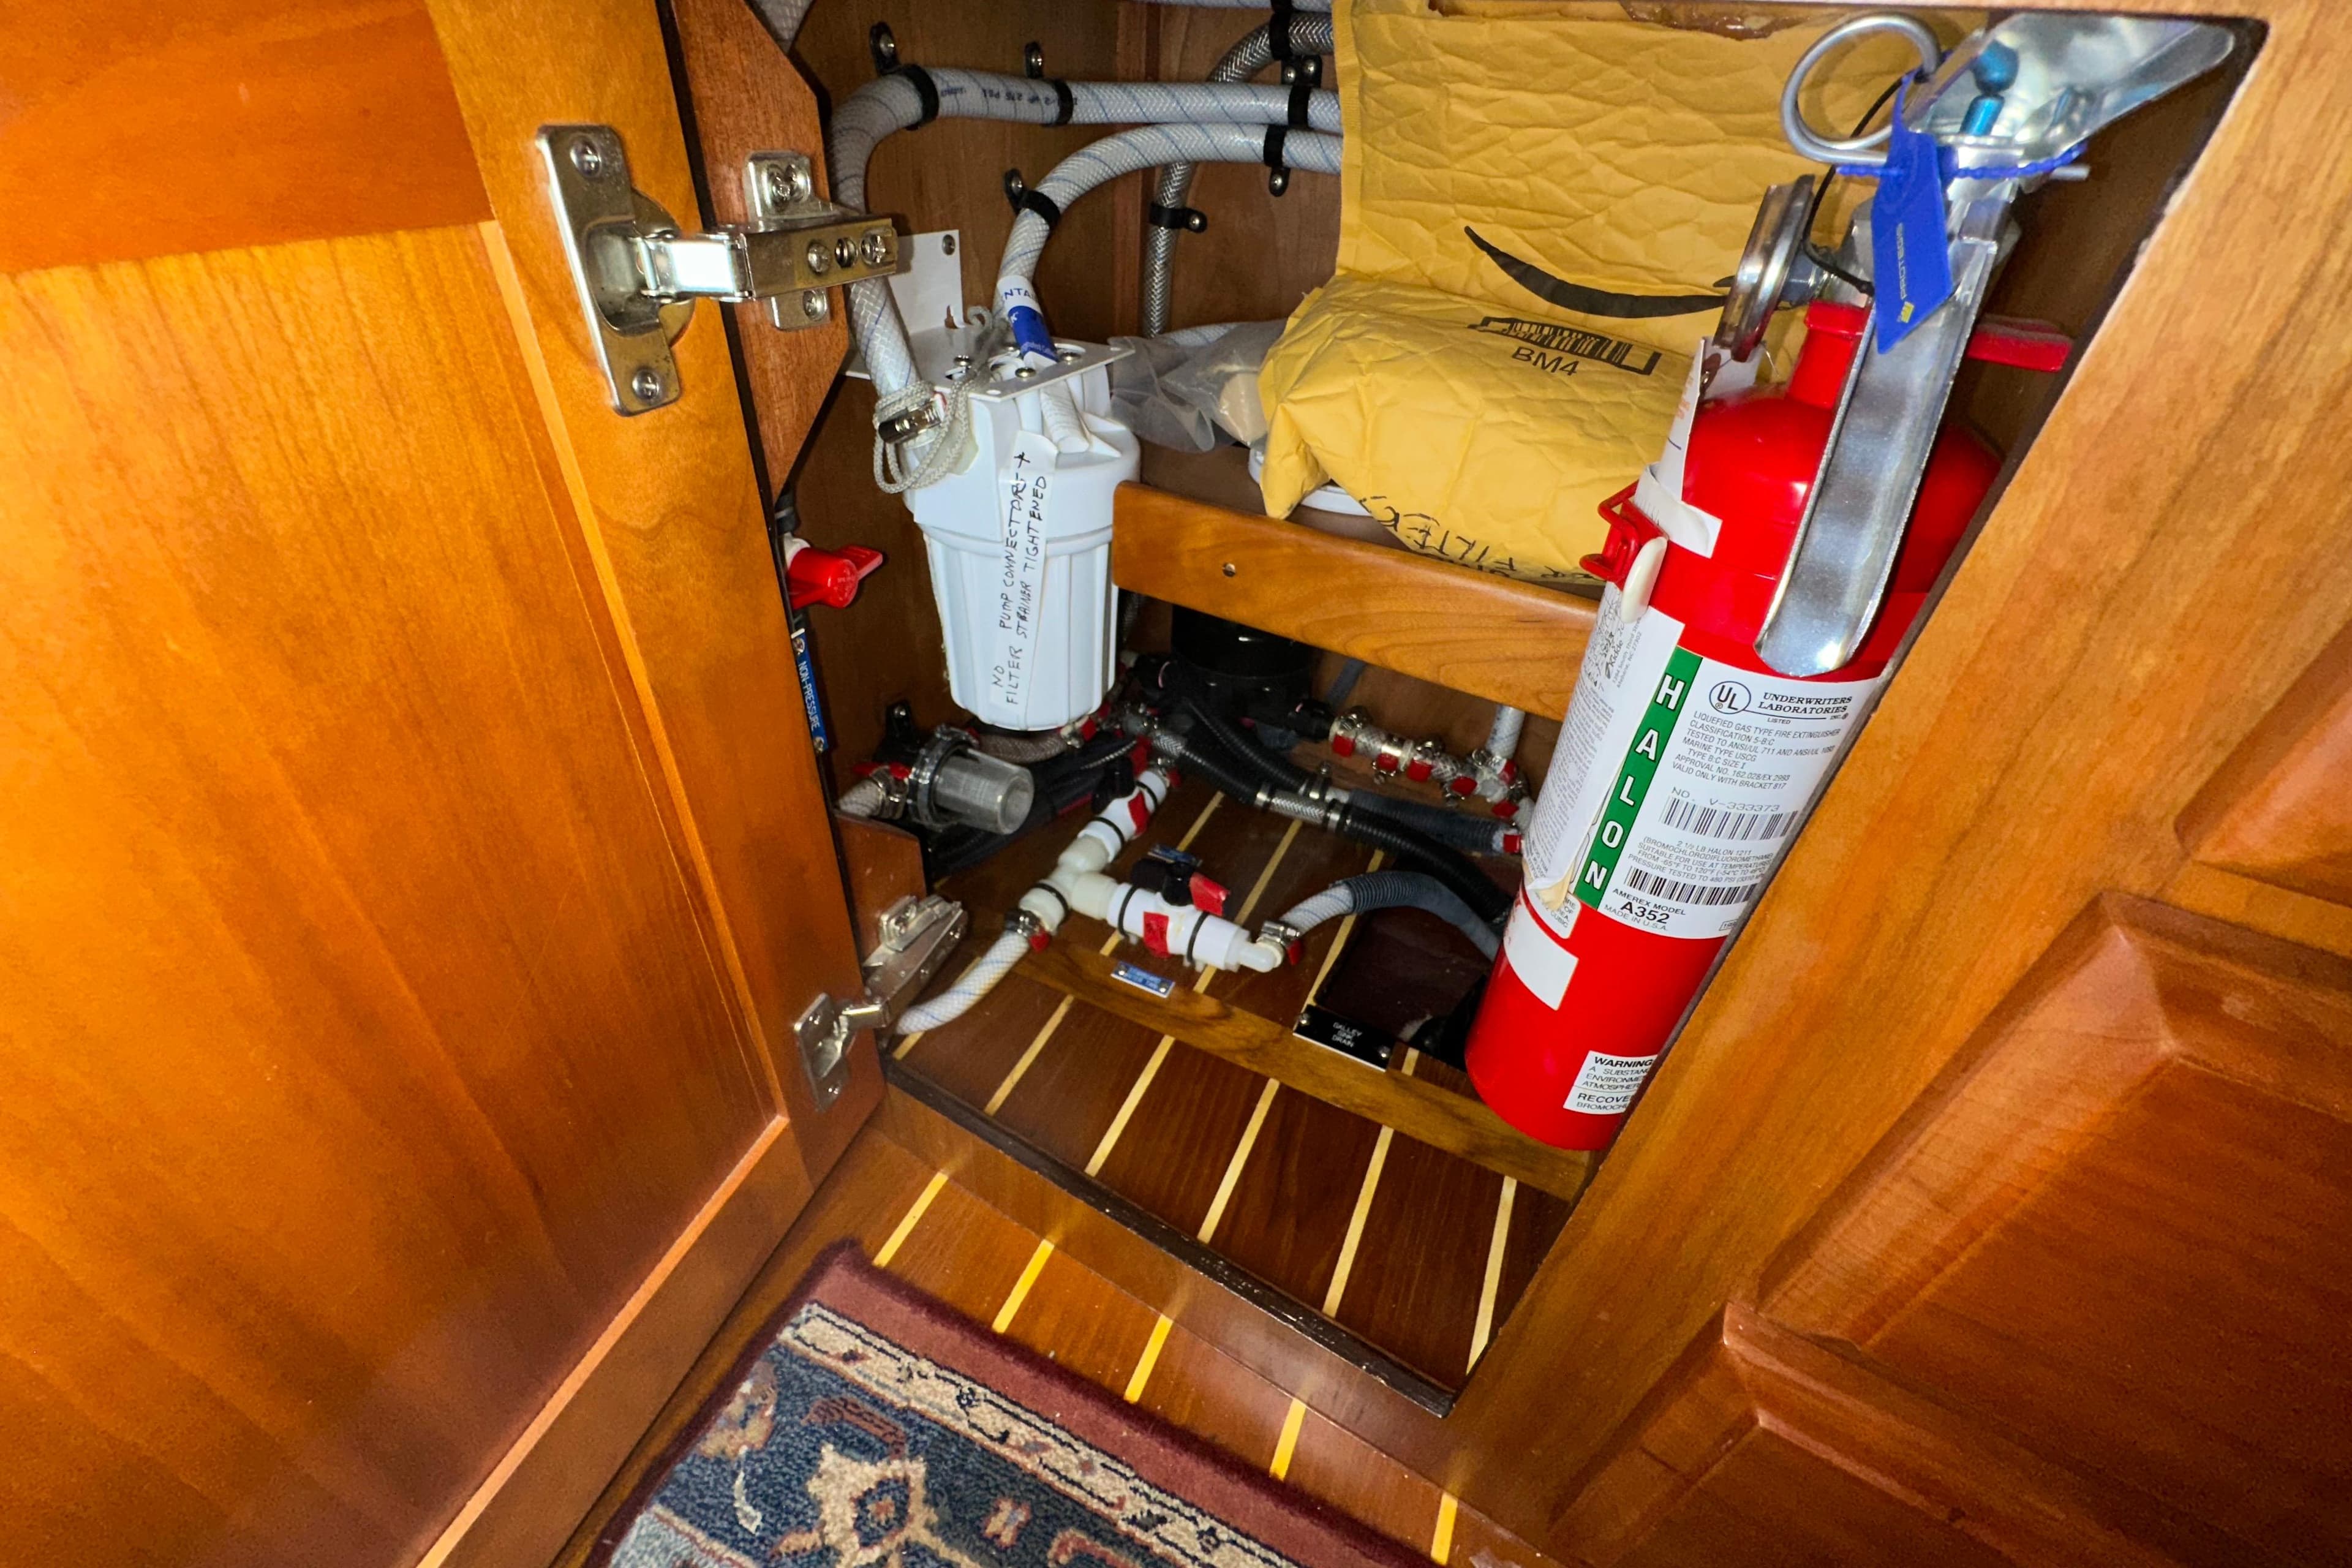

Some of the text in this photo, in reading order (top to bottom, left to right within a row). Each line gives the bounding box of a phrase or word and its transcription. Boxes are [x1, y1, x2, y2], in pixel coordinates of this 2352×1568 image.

[1511, 346, 1580, 376] BM4
[1006, 475, 1047, 705] FILTER STRAINER TIGHTENED
[999, 592, 1014, 630] PUMP
[1608, 639, 1623, 668] Kidde
[798, 660, 821, 731] NON-PRESSURE
[1717, 685, 1738, 710] UL
[1758, 701, 1848, 714] LABORATORIES
[1763, 692, 1852, 705] UNDERWRITERS
[1690, 720, 1752, 742] CLASSIFICATION
[1694, 711, 1733, 728] LIQUEFIED
[1735, 723, 1752, 733] GAS
[1754, 727, 1774, 736] TYPE
[1774, 729, 1792, 739] FIRE
[1682, 736, 1757, 762] MARINE TYPE USCG
[1687, 728, 1715, 743] TESTED
[1717, 738, 1727, 747] TO
[1728, 741, 1759, 754] ANSI/UL
[1675, 754, 1714, 772] APPROVAL
[1716, 766, 1730, 776] NO.
[1688, 748, 1708, 760] TYPE
[1722, 759, 1740, 768] SIZE
[1584, 673, 1686, 891] HALON
[1672, 761, 1695, 775] VALID
[1695, 770, 1716, 781] ONLY
[1717, 776, 1738, 786] WITH
[1738, 780, 1773, 790] BRACKET
[1709, 798, 1781, 812] V-333373
[1638, 842, 1674, 860] SUITABLE
[1638, 850, 1659, 863] FROM
[1628, 853, 1667, 873] PRESSURE
[1668, 869, 1697, 880] TESTED
[1604, 905, 1629, 919] MADE
[1612, 889, 1686, 916] AMEREX MODEL
[1620, 902, 1670, 924] A352
[1594, 1057, 1654, 1068] WARNING
